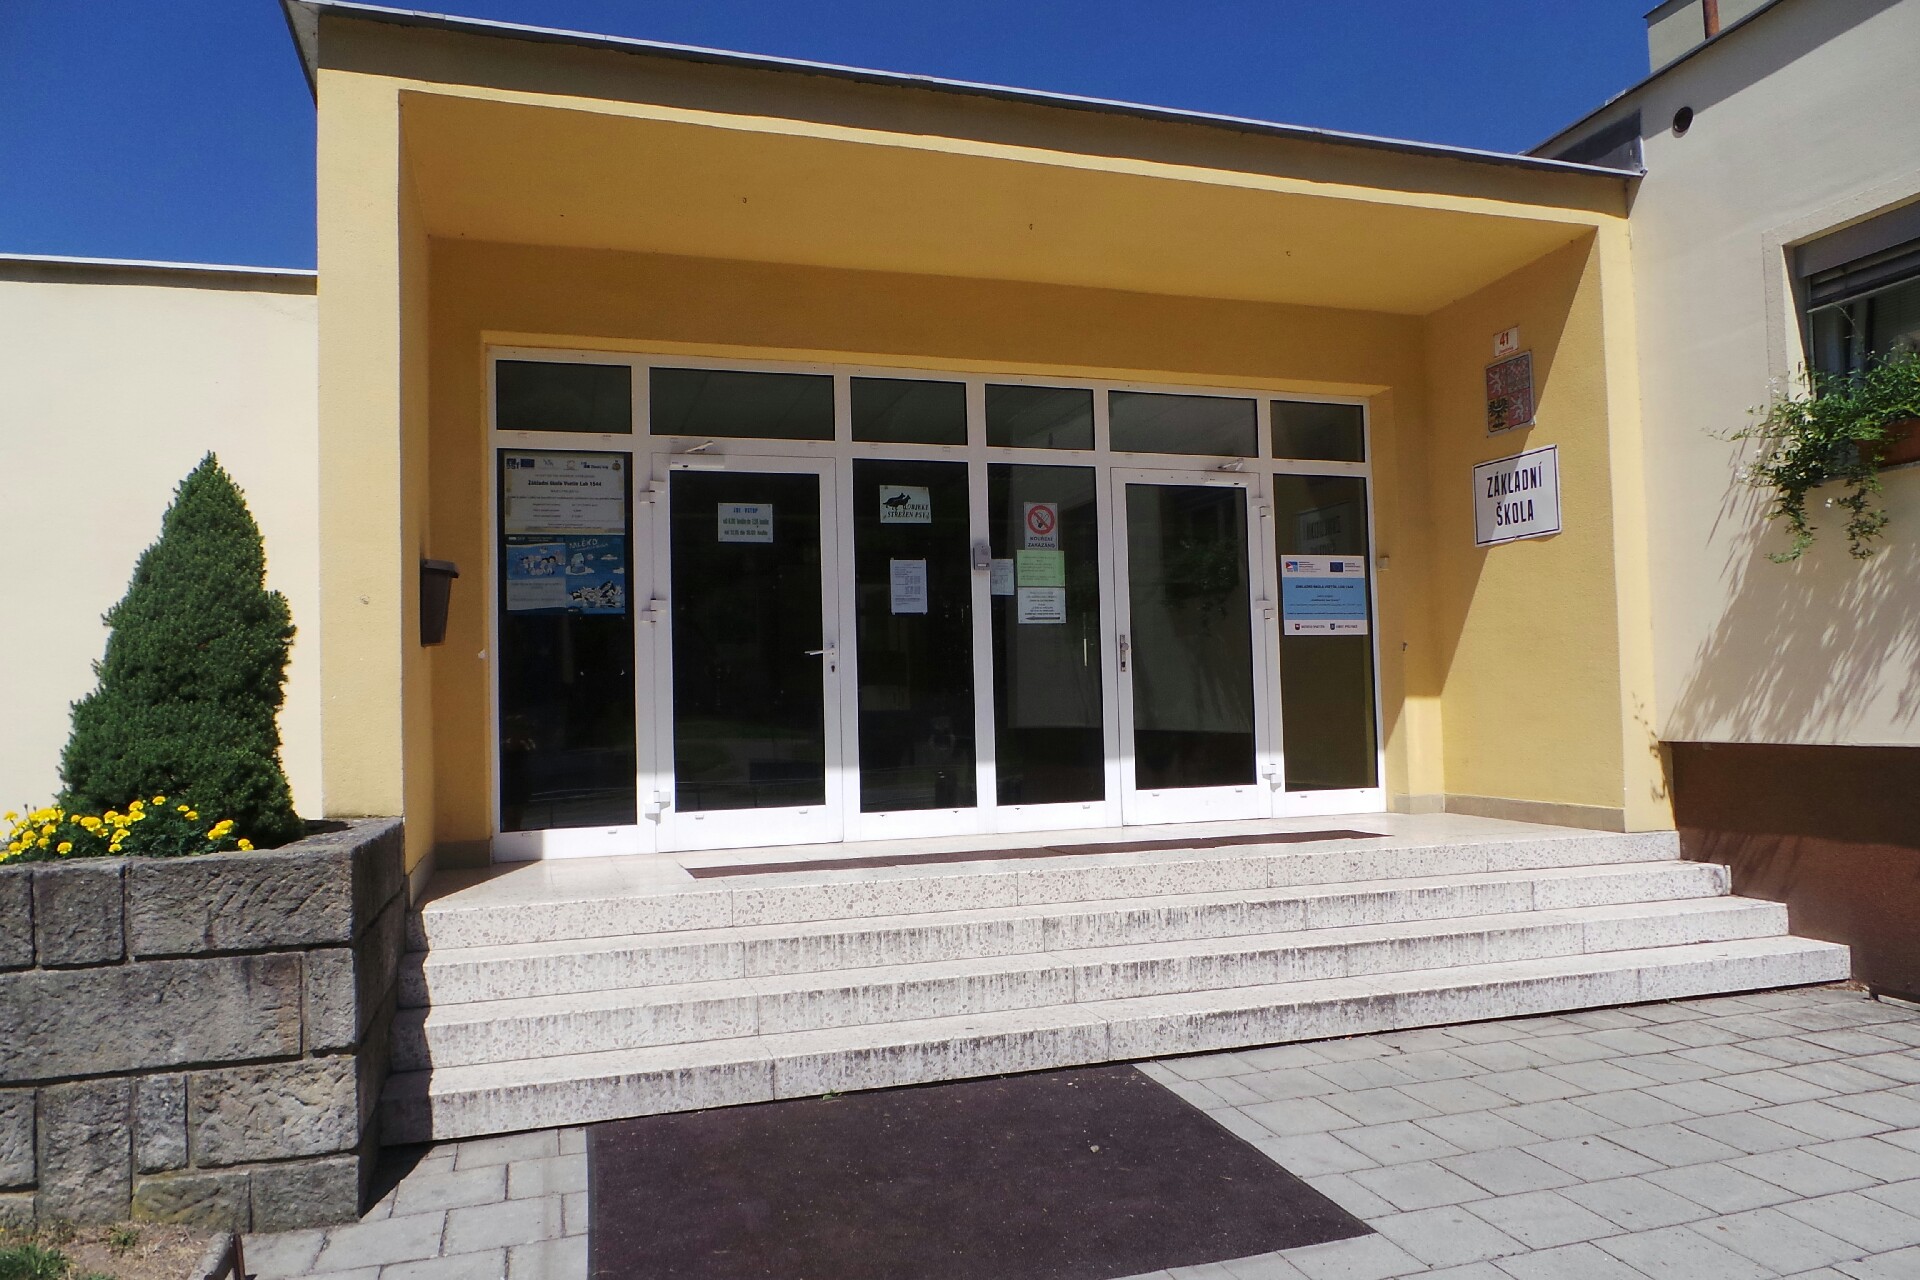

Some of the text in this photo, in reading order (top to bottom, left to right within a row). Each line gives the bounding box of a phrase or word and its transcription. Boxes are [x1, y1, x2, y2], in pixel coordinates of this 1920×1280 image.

[1499, 332, 1509, 346] 41
[1486, 461, 1542, 498] ZÁKLADNÍ
[1496, 499, 1534, 526] ŠKOLA
